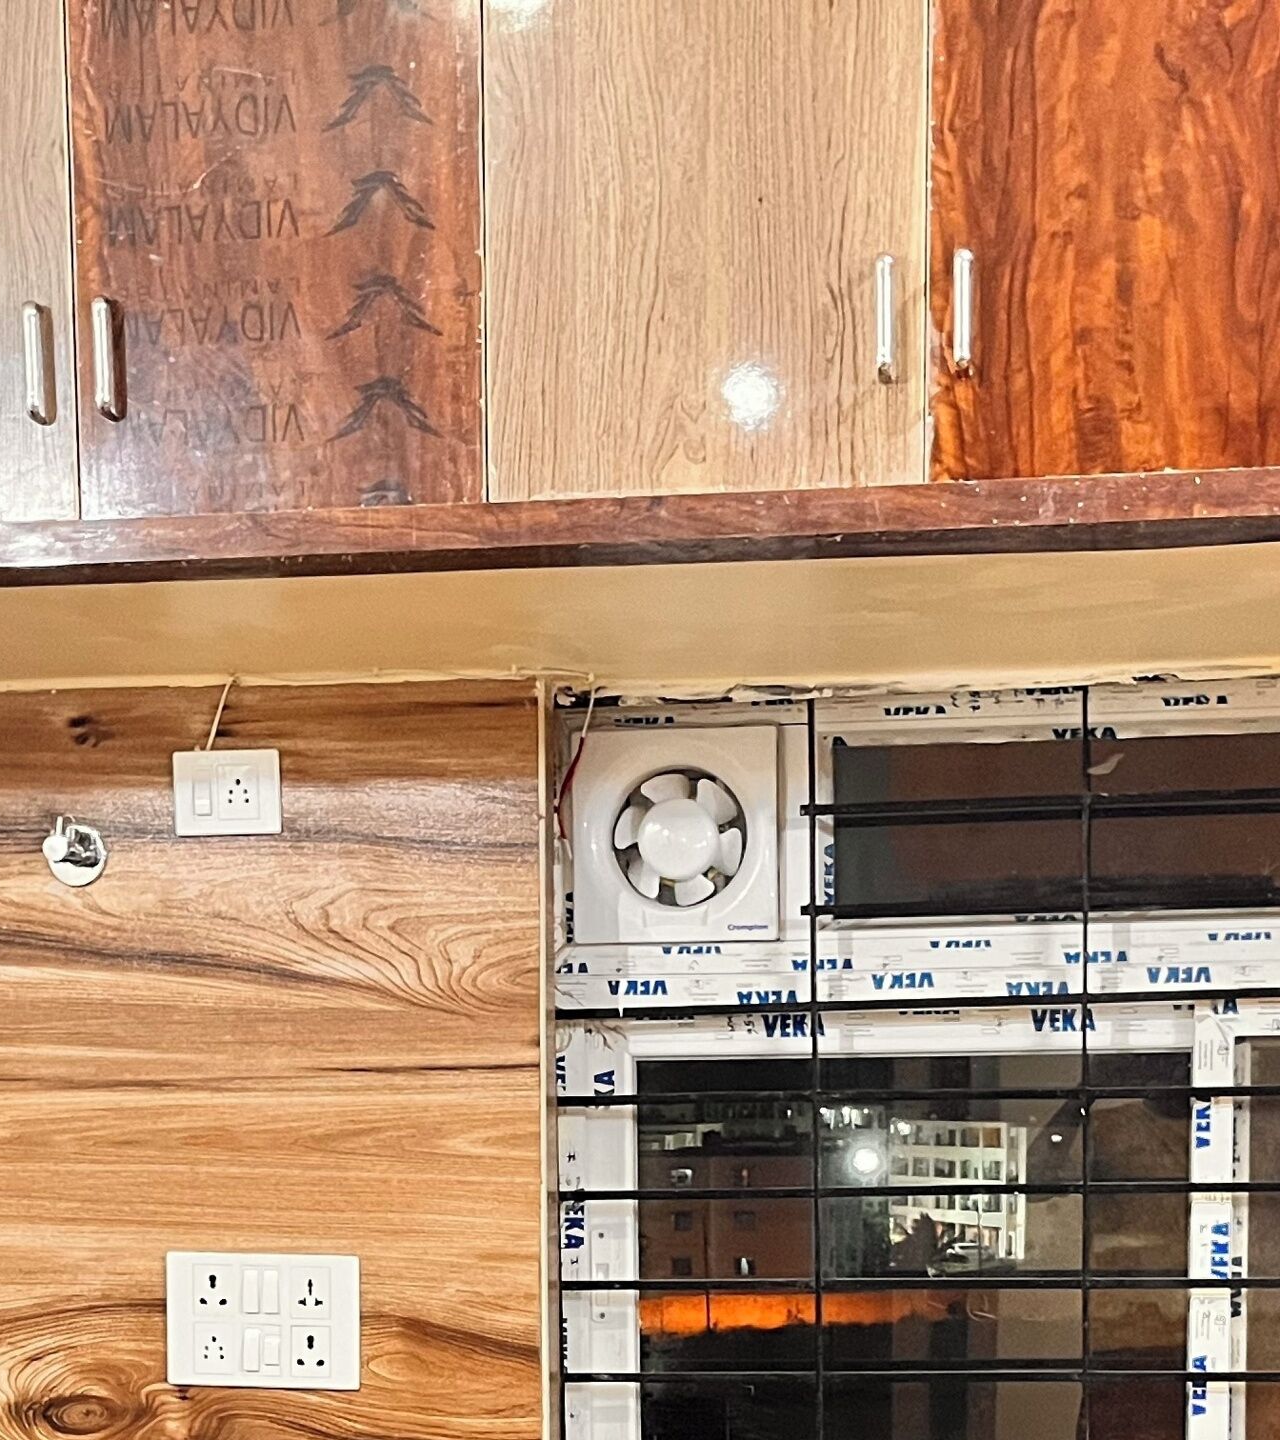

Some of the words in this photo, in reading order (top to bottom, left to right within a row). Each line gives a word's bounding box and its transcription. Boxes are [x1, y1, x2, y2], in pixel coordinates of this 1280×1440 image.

[105, 92, 297, 144] VIDYALAM
[108, 199, 301, 247] VIDYALAM
[871, 972, 934, 990] VEKA
[1146, 967, 1211, 983] VEKA
[608, 980, 668, 996] VEKA
[1031, 1008, 1096, 1032] VEKA
